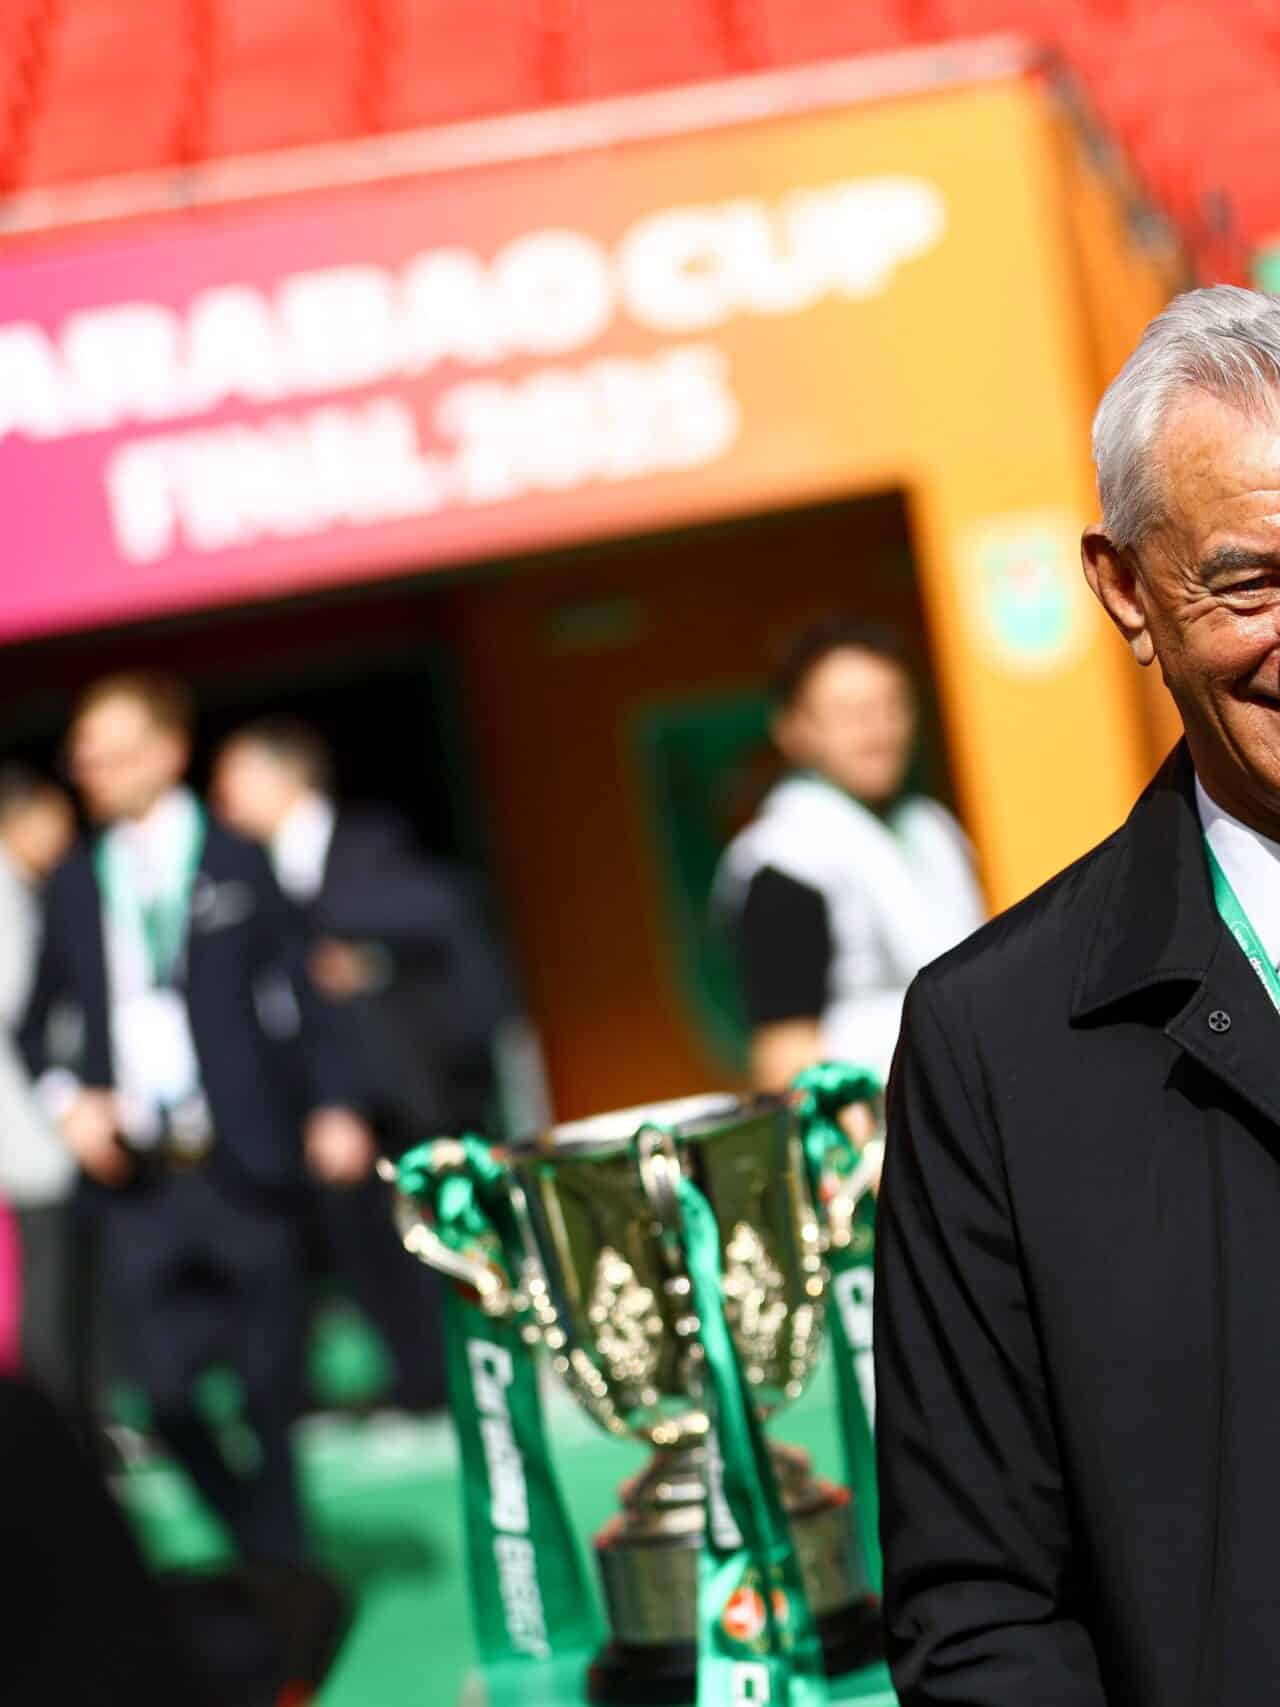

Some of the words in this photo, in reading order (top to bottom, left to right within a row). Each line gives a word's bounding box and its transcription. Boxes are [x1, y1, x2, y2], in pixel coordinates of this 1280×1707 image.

[618, 176, 943, 332] CUP
[107, 398, 438, 563] FINAL
[434, 344, 738, 500] 2025
